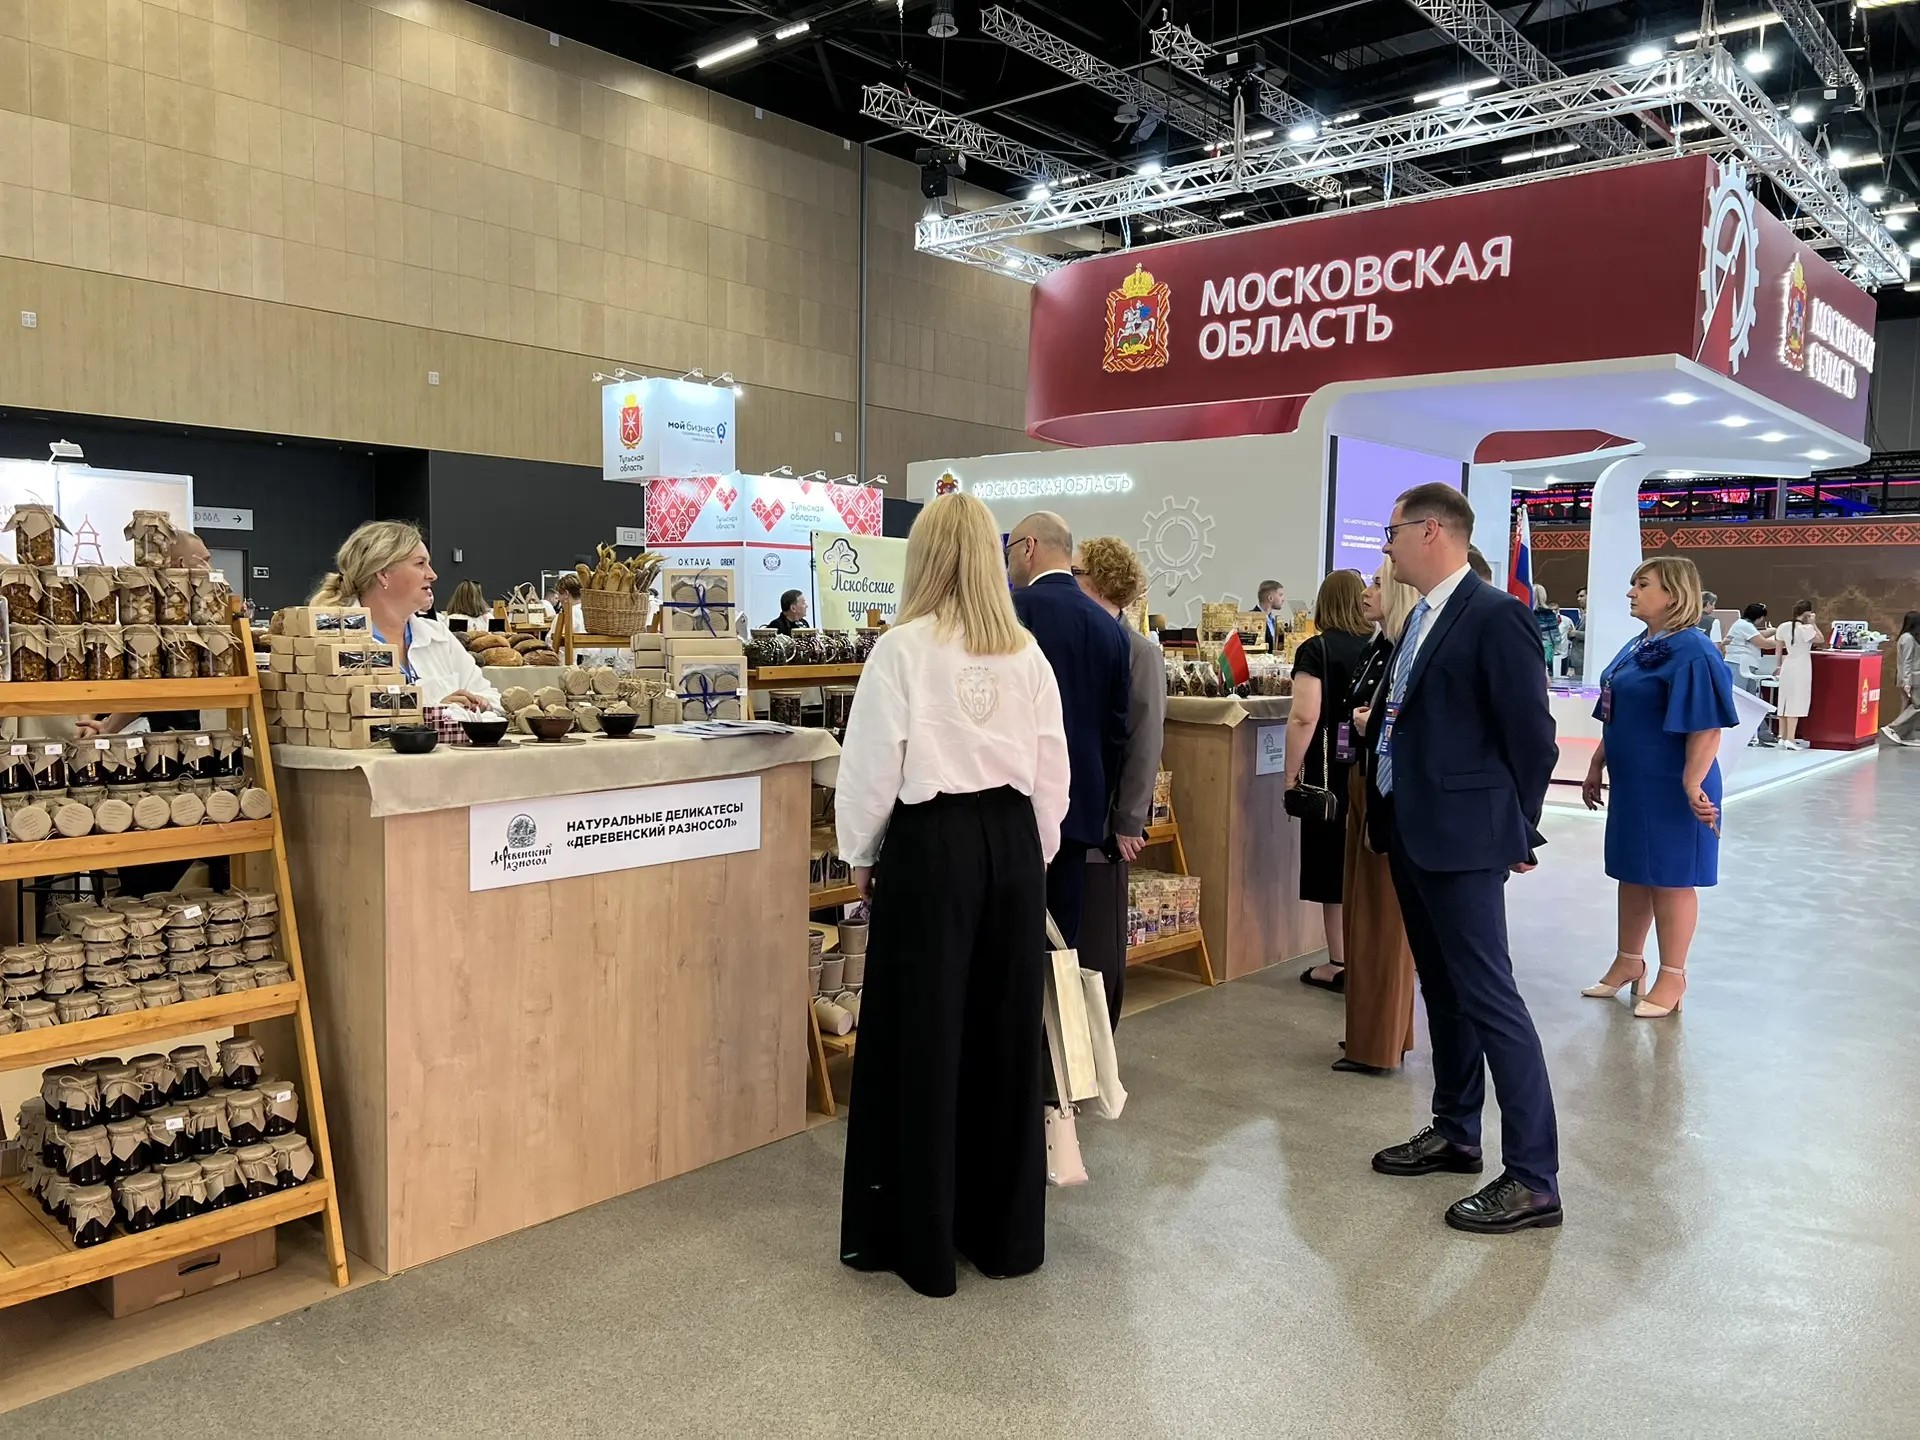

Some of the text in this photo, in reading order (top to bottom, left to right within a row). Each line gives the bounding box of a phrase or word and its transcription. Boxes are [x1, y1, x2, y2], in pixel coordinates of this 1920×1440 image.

[1200, 235, 1513, 317] МОСКОВСКАЯ
[1198, 303, 1393, 361] ОБЛАСТЬ
[1810, 341, 1857, 400] ОБЛАСТЬ
[667, 420, 716, 434] мой бизнес
[619, 454, 645, 464] Тульская
[619, 463, 643, 472] область
[973, 473, 1131, 498] МОСКОВСКАЯ ОБЛАСТЬ
[790, 501, 824, 512] Тульская
[790, 512, 821, 523] область
[678, 558, 711, 566] OKTAVA
[831, 569, 895, 594] Псковские
[566, 802, 744, 832] НАТУРАЛЬНЫЕ ДЕЛИКАТЕСЫ
[566, 818, 738, 848] «ДЕРЕВЕНСКИЙ РАЗНОСОЛ»
